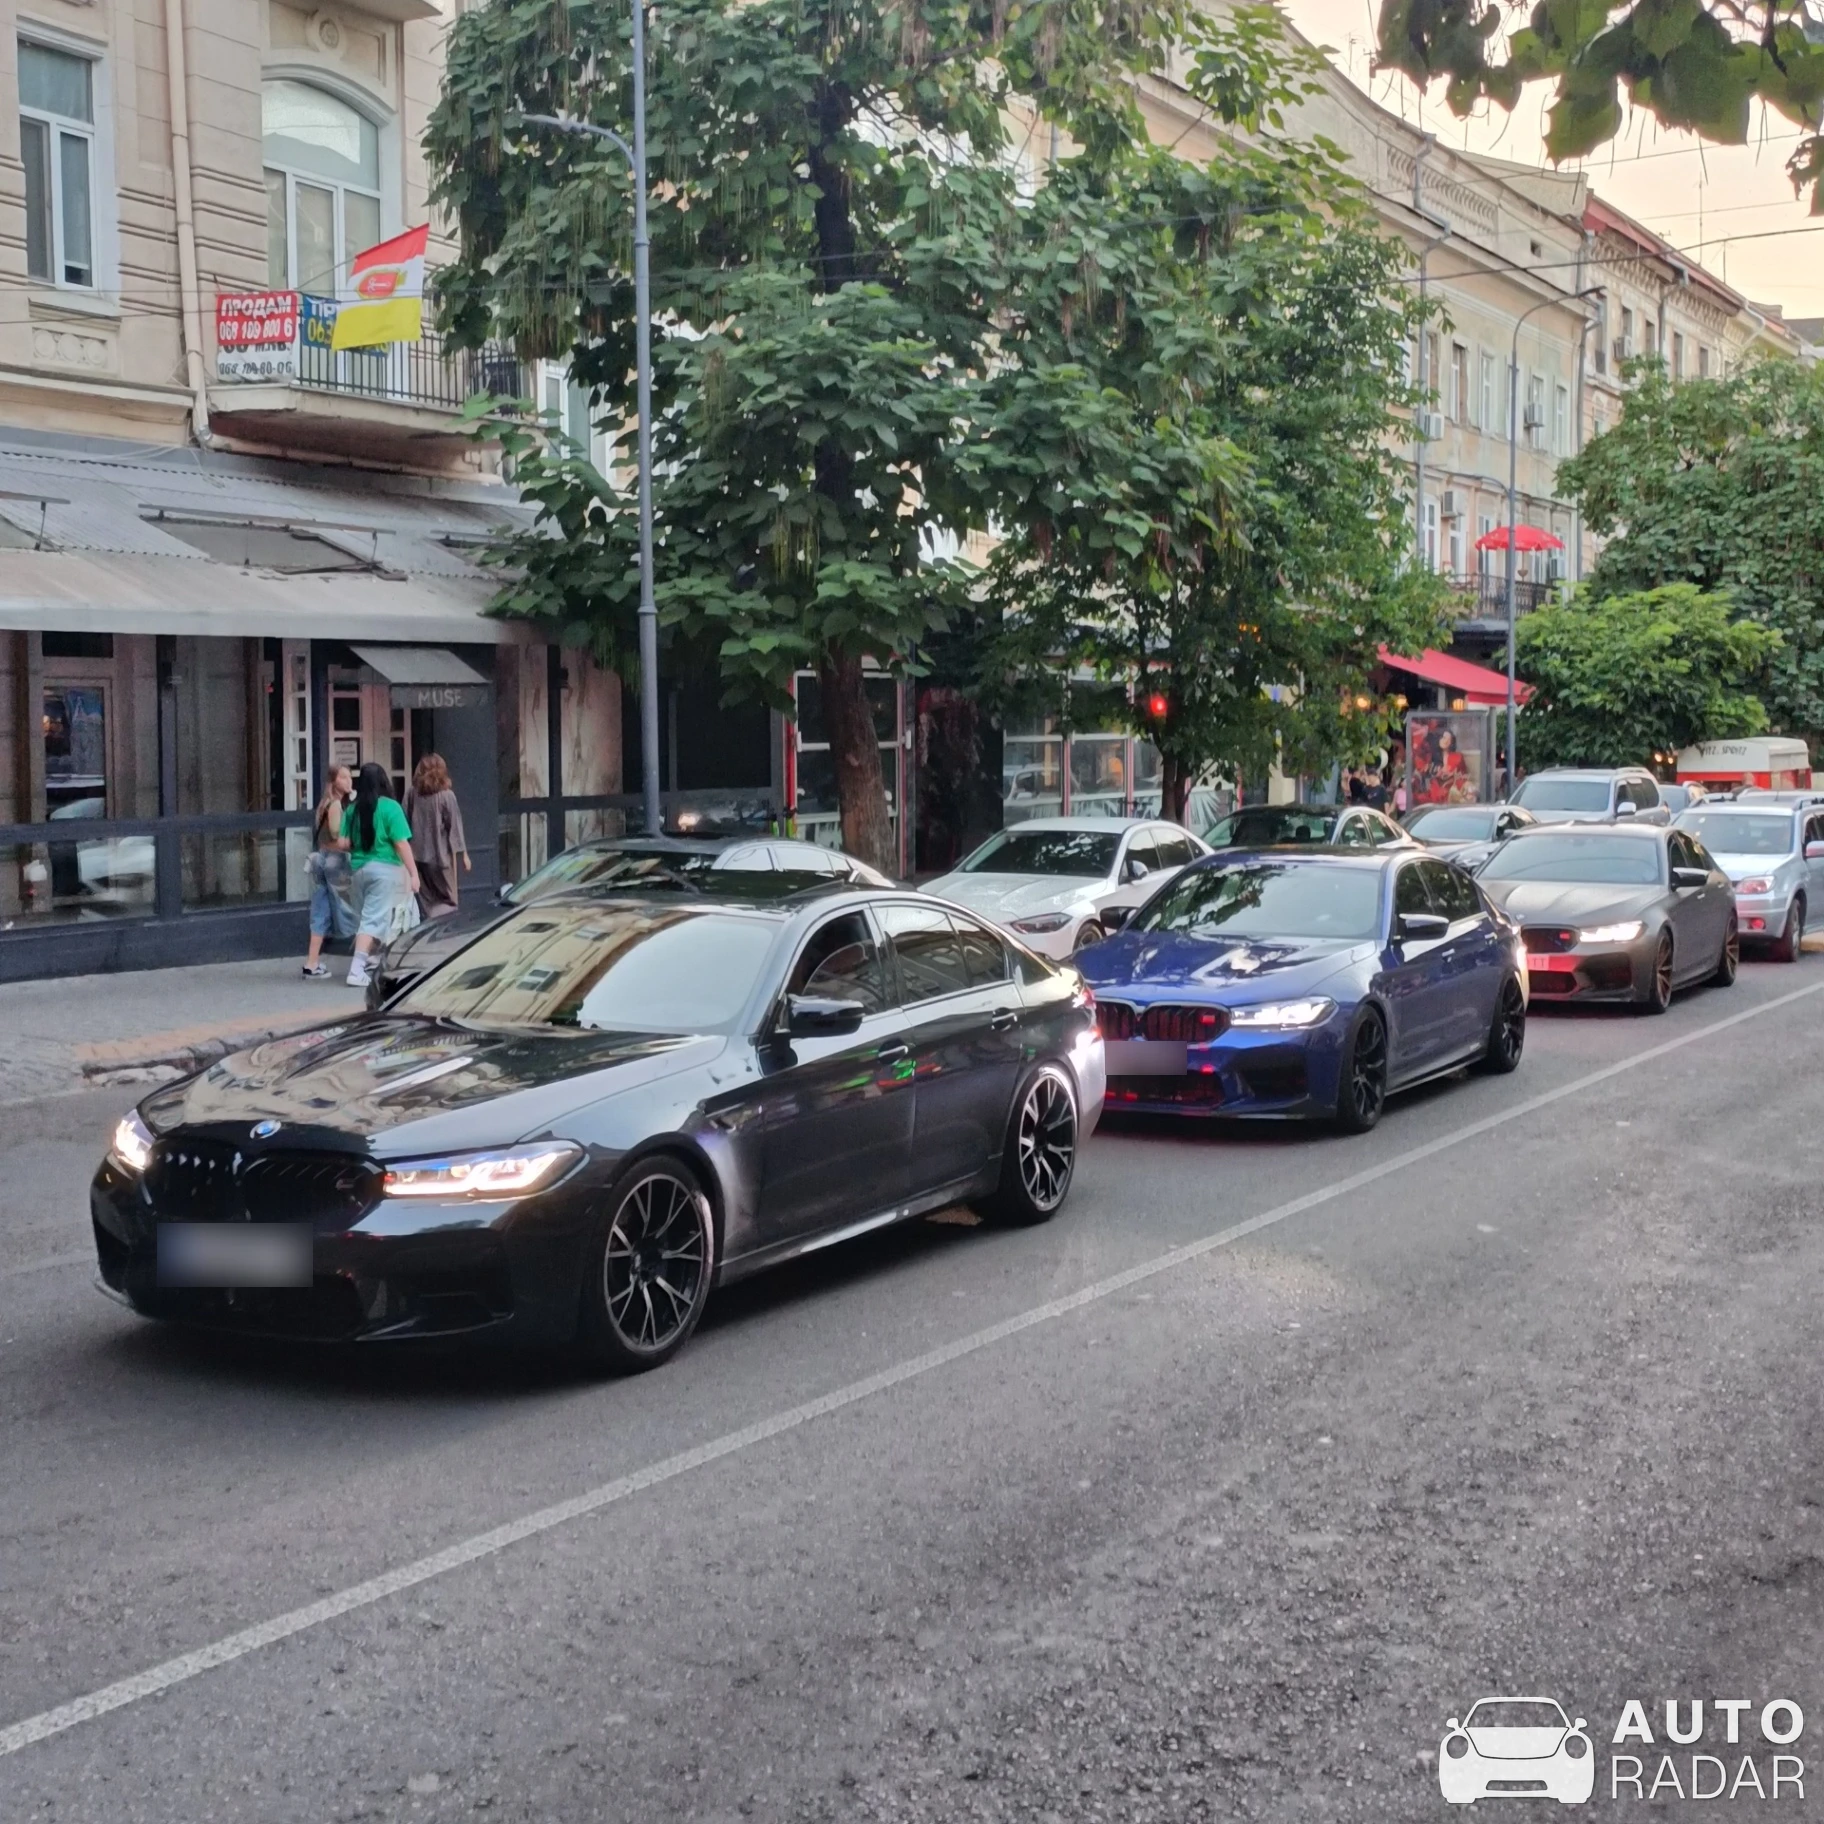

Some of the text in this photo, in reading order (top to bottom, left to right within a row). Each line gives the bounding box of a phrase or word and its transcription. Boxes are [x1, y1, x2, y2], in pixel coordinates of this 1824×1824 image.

[220, 295, 292, 319] ПРОДАМ
[220, 317, 293, 340] 068 109 800 6
[418, 689, 465, 708] MUSE
